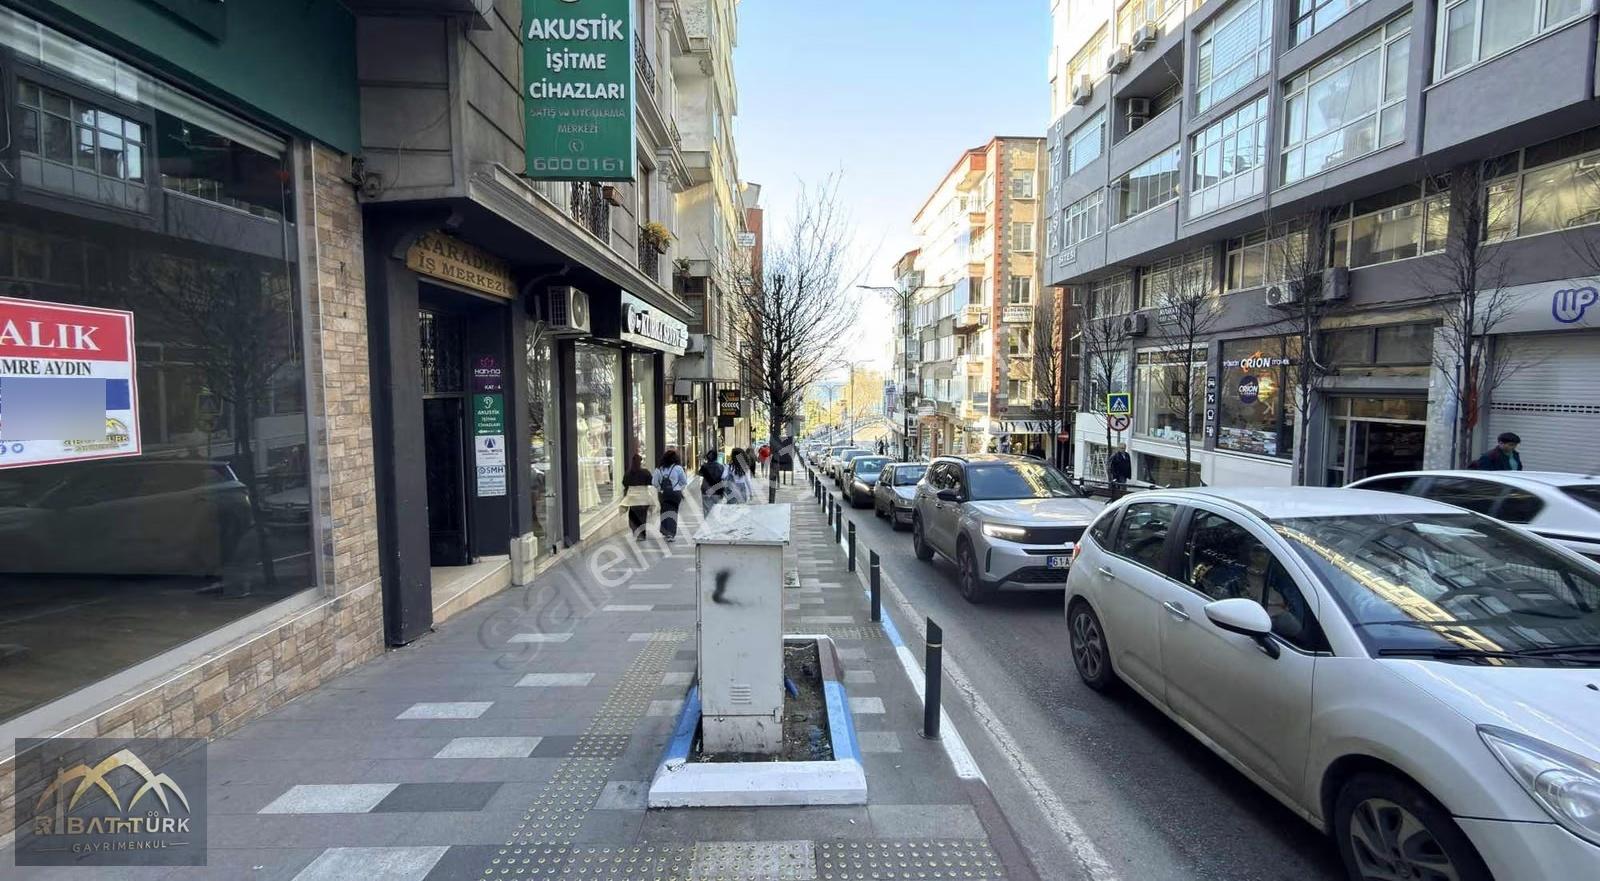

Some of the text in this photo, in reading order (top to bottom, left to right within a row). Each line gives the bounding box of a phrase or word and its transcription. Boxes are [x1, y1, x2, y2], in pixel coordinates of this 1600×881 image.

[528, 14, 624, 40] AKUSTİK
[546, 48, 606, 72] İŞİTME
[529, 78, 624, 99] CİHAZLARI
[530, 107, 556, 118] SATIŞ
[533, 158, 624, 171] 600 0161
[418, 251, 436, 273] İŞ
[0, 360, 92, 376] MRE AYDIN
